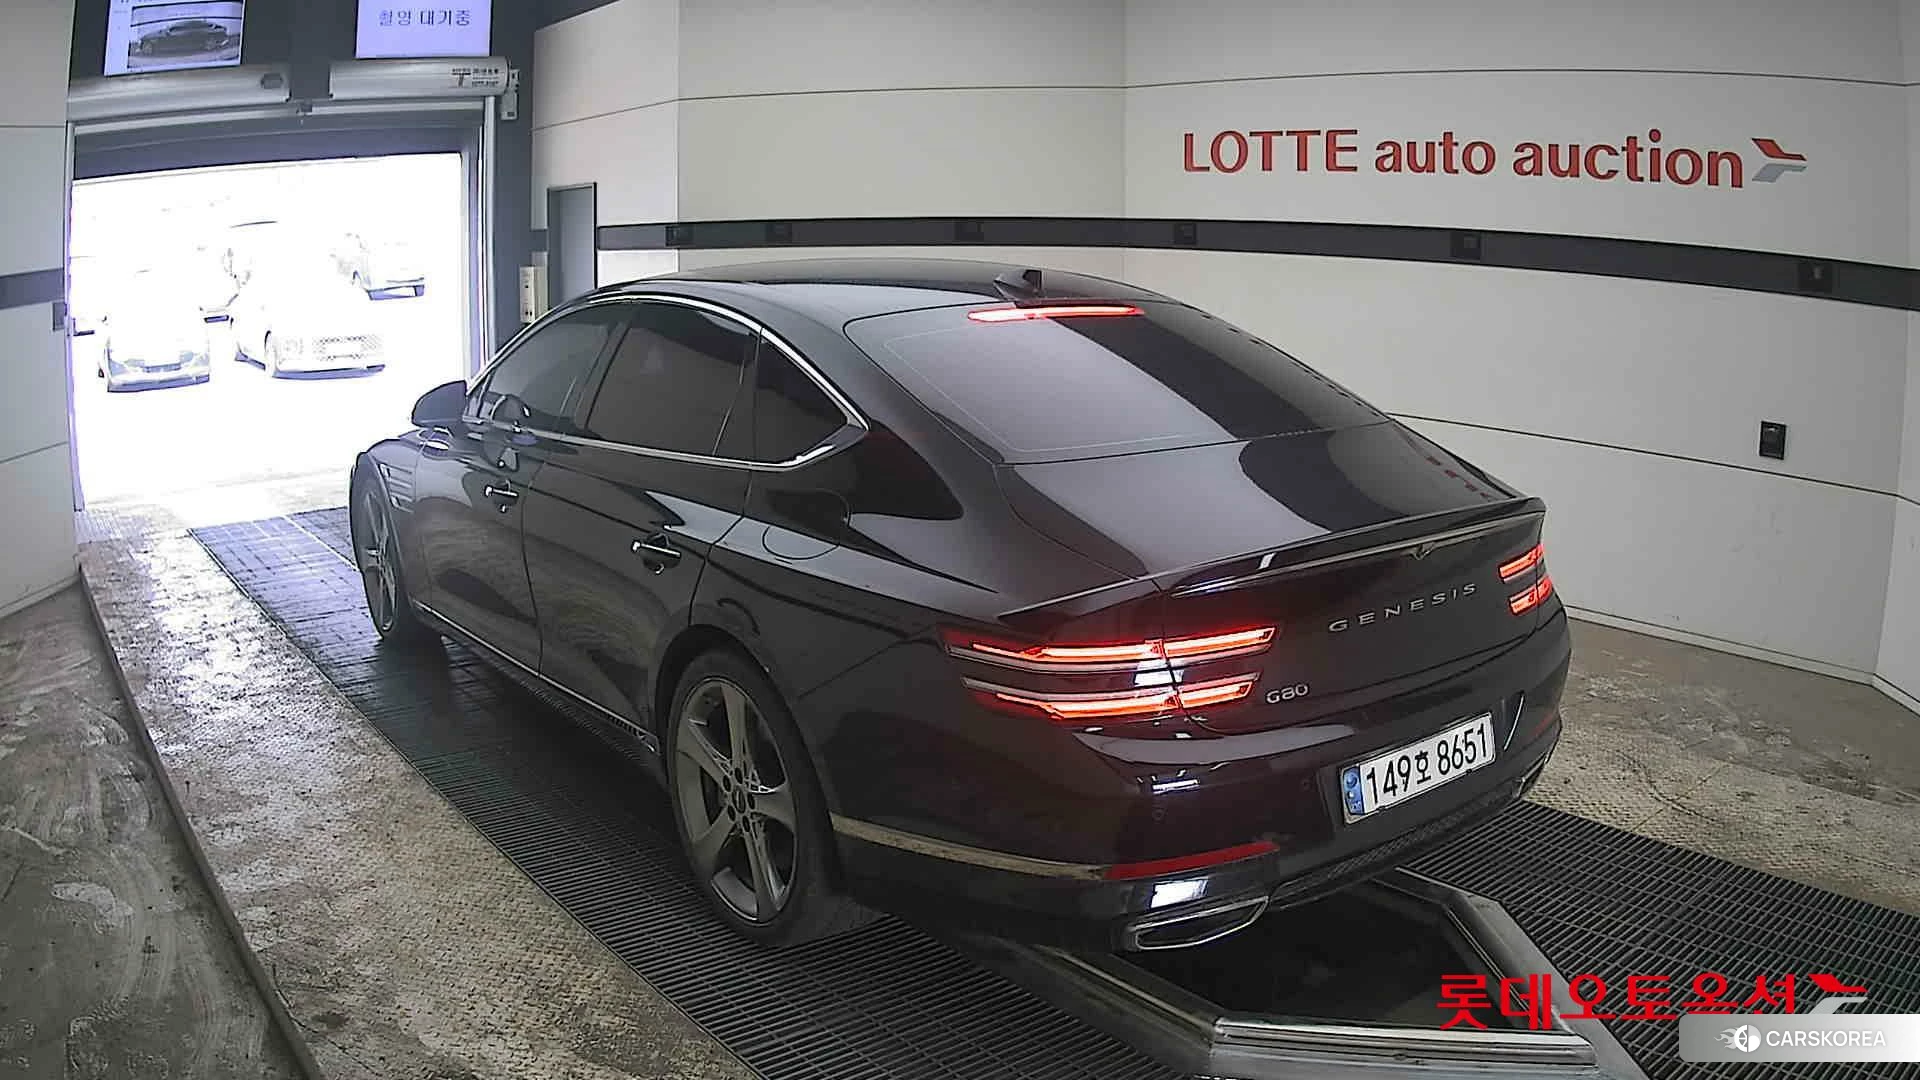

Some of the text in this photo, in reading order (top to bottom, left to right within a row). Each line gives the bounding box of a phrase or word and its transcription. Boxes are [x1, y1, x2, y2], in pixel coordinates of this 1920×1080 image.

[420, 9, 471, 27] 대기중
[1183, 128, 1745, 189] LOTTE auto auction
[1328, 583, 1478, 633] GENESIS
[1265, 683, 1310, 704] G80
[1366, 722, 1488, 805] 149호 8651
